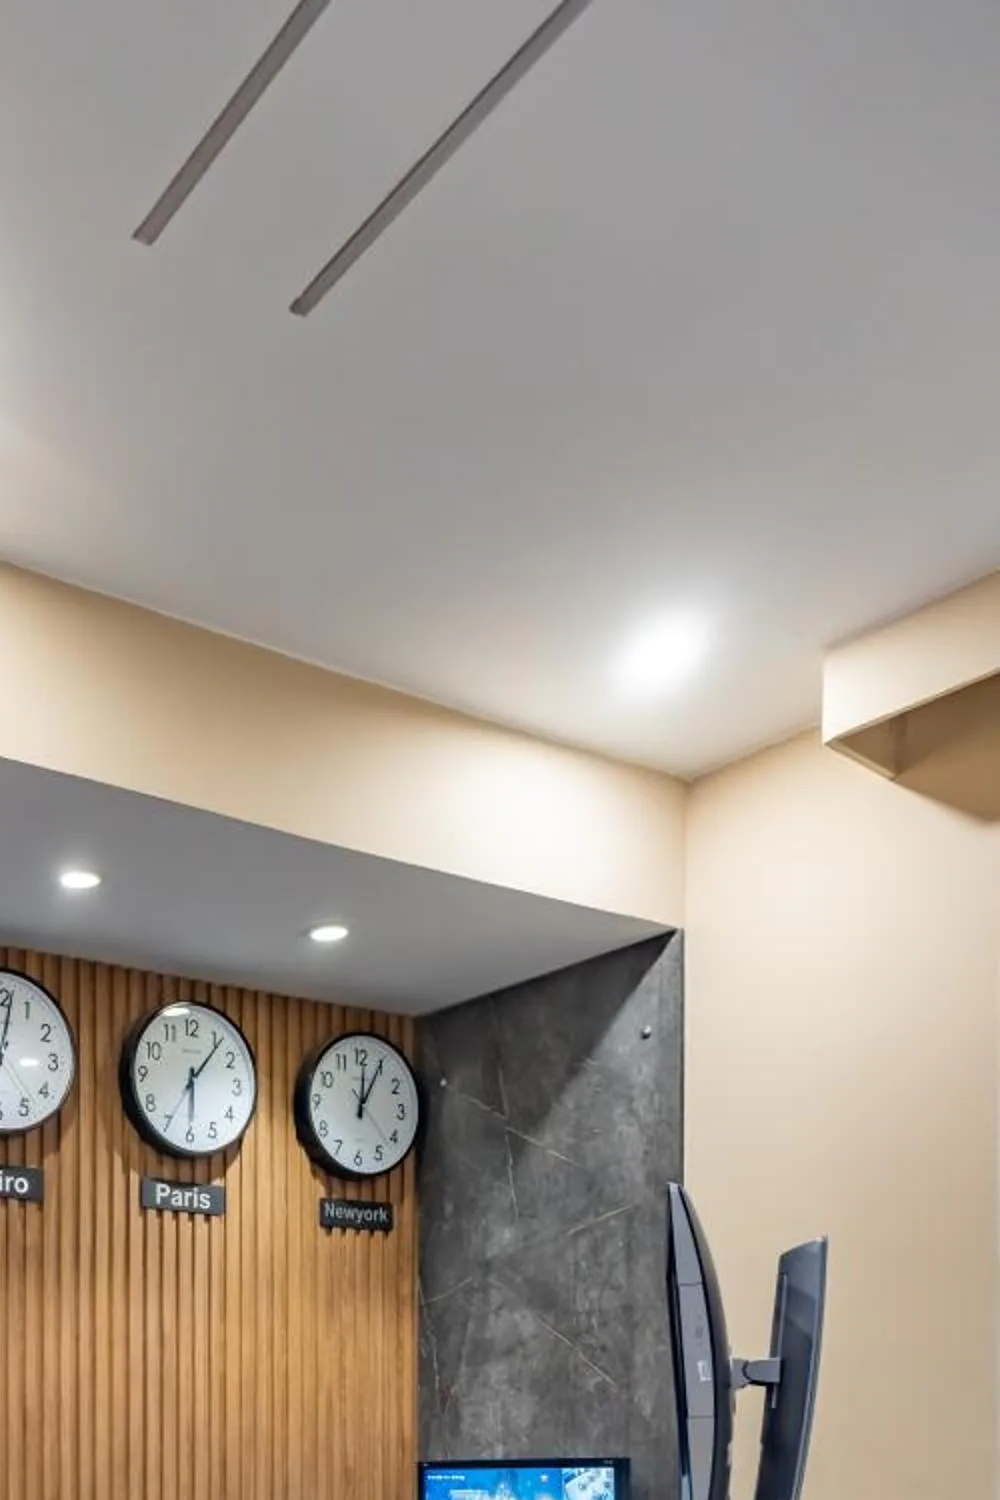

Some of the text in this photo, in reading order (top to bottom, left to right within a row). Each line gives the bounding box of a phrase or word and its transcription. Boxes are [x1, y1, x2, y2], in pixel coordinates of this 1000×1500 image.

[24, 1002, 30, 1020] 1
[40, 1023, 51, 1043] 2
[164, 1024, 176, 1042] 11
[184, 1018, 199, 1038] 12
[146, 1041, 161, 1060] 10
[354, 1048, 368, 1066] 12
[48, 1054, 59, 1071] 3
[225, 1052, 236, 1069] 2
[335, 1053, 347, 1072] 11
[138, 1066, 148, 1082] 9
[321, 1071, 334, 1088] 10
[39, 1082, 49, 1098] 4
[232, 1080, 242, 1096] 3
[392, 1078, 400, 1095] 2
[18, 1098, 29, 1116] 5
[145, 1094, 156, 1112] 8
[312, 1093, 321, 1109] 9
[224, 1105, 233, 1122] 4
[396, 1104, 405, 1120] 3
[185, 1126, 194, 1143] 6
[208, 1122, 217, 1138] 5
[319, 1120, 329, 1137] 8
[389, 1129, 398, 1144] 4
[333, 1140, 343, 1155] 7
[374, 1144, 383, 1161] 5
[353, 1151, 362, 1166] 6
[155, 1183, 211, 1209] Paris
[324, 1202, 389, 1223] Newyork
